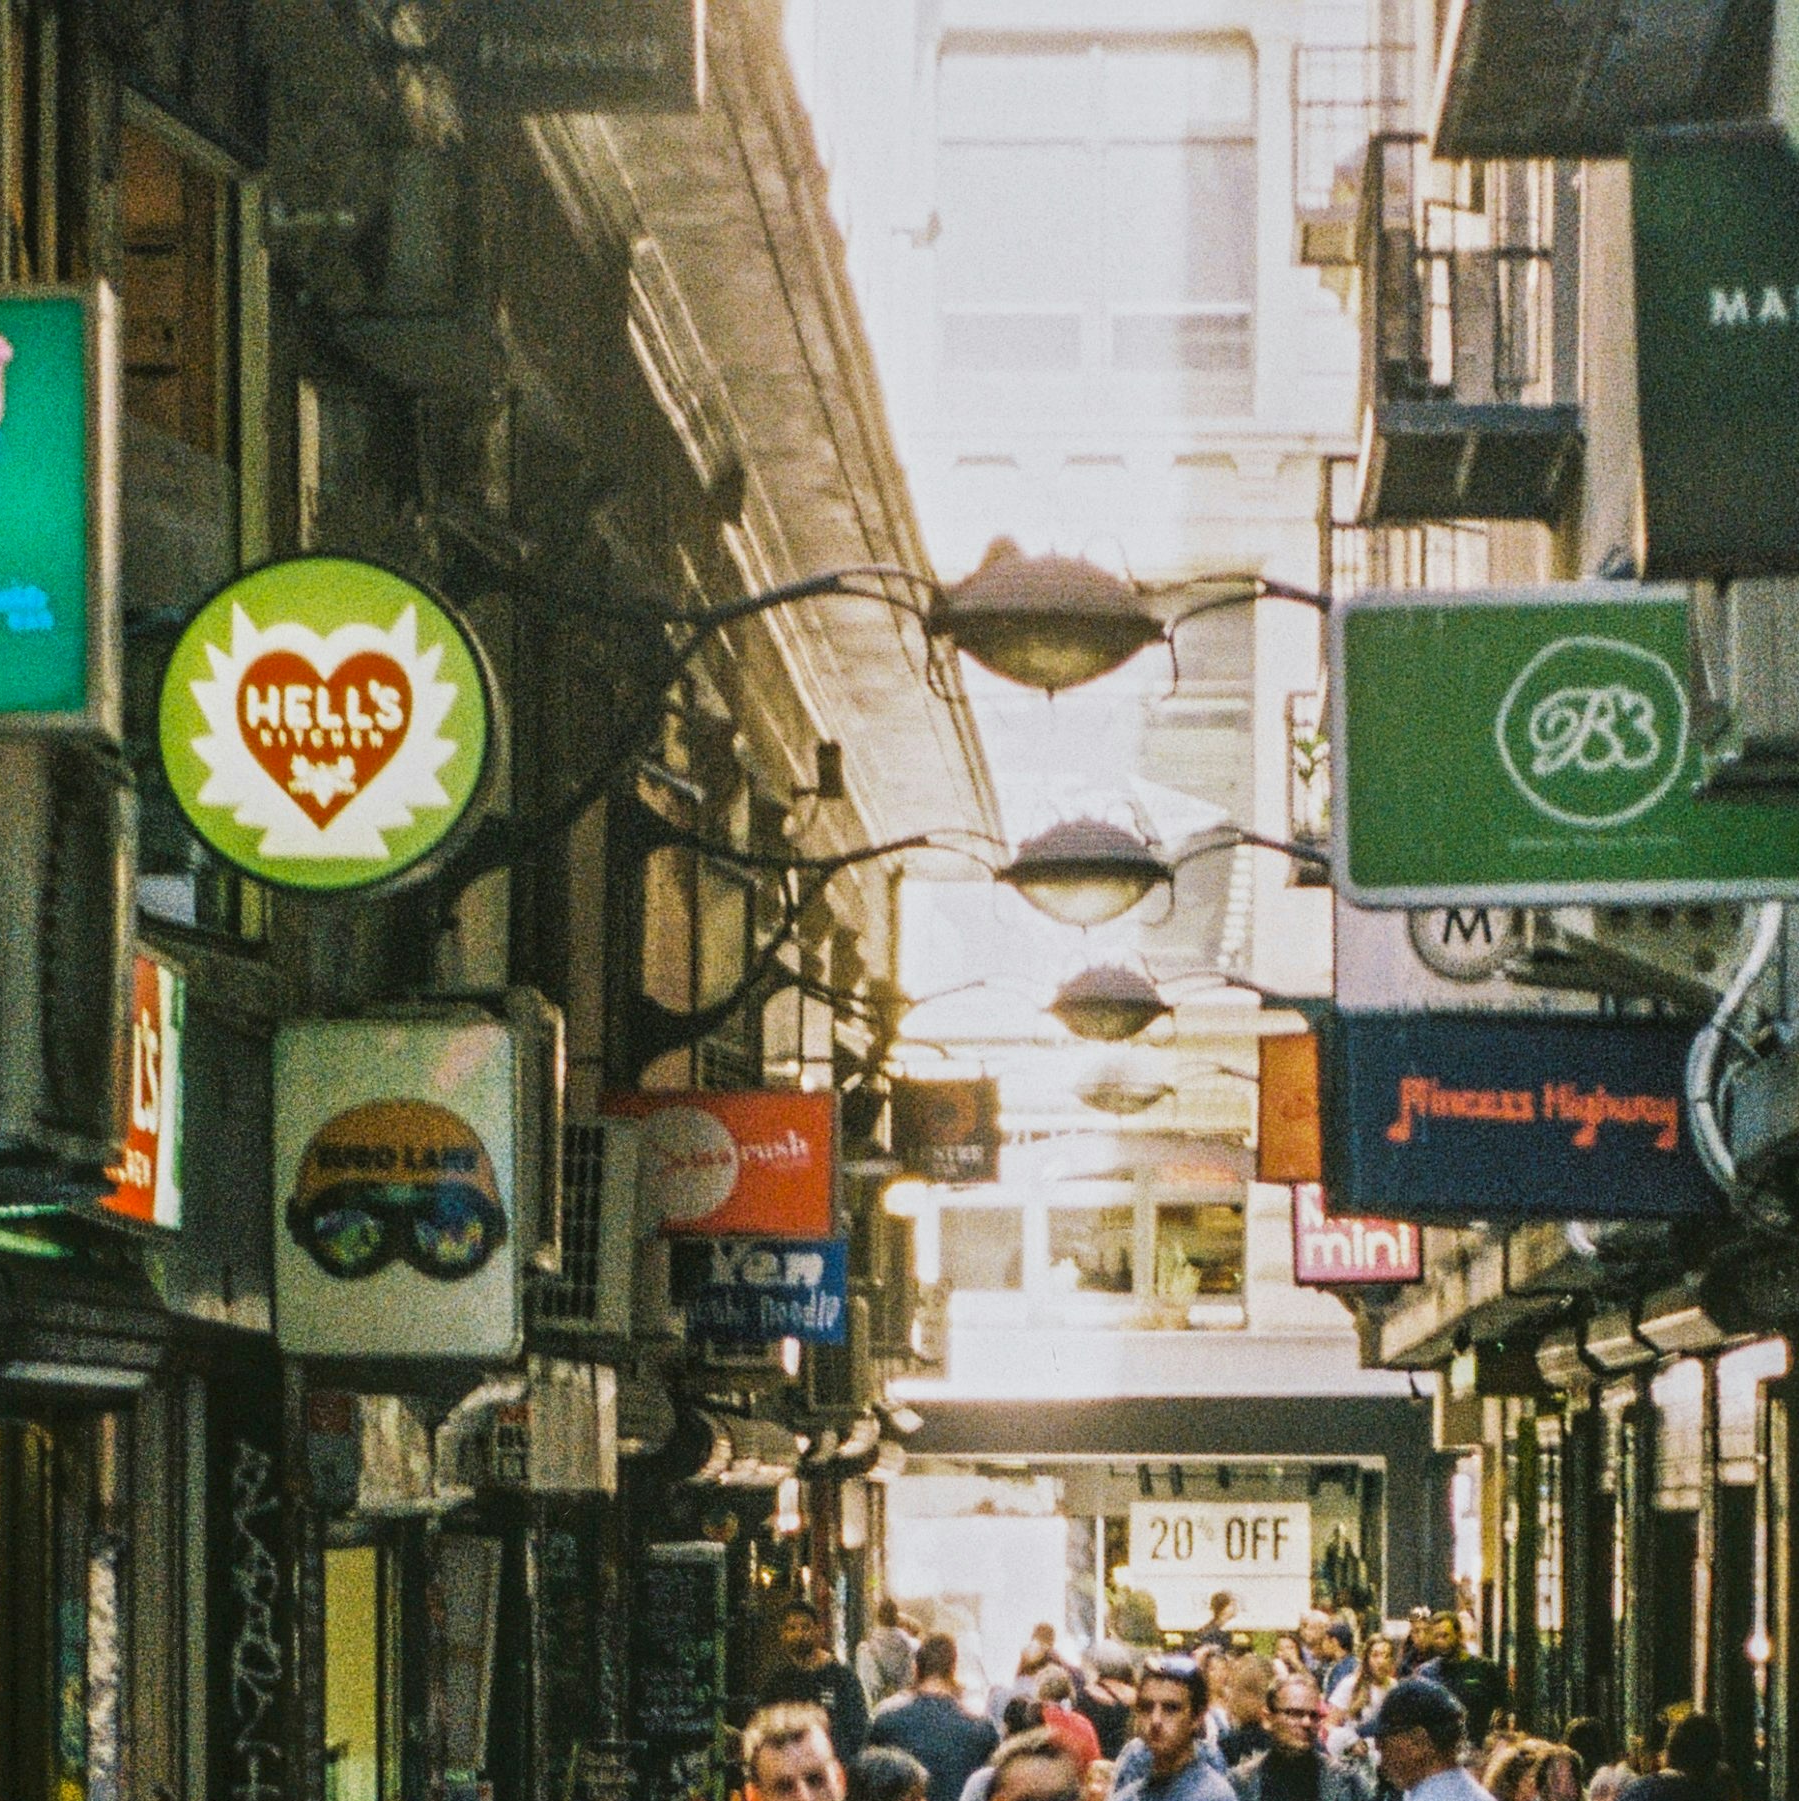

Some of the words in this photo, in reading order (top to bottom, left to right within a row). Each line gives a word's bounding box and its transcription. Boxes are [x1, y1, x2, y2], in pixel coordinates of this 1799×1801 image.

[245, 678, 404, 732] HELL'S
[259, 728, 384, 750] KITCHEN
[1542, 1080, 1679, 1150] Highway
[712, 1242, 825, 1288] Yen
[1304, 1220, 1411, 1269] mini
[1225, 1514, 1289, 1561] OFF
